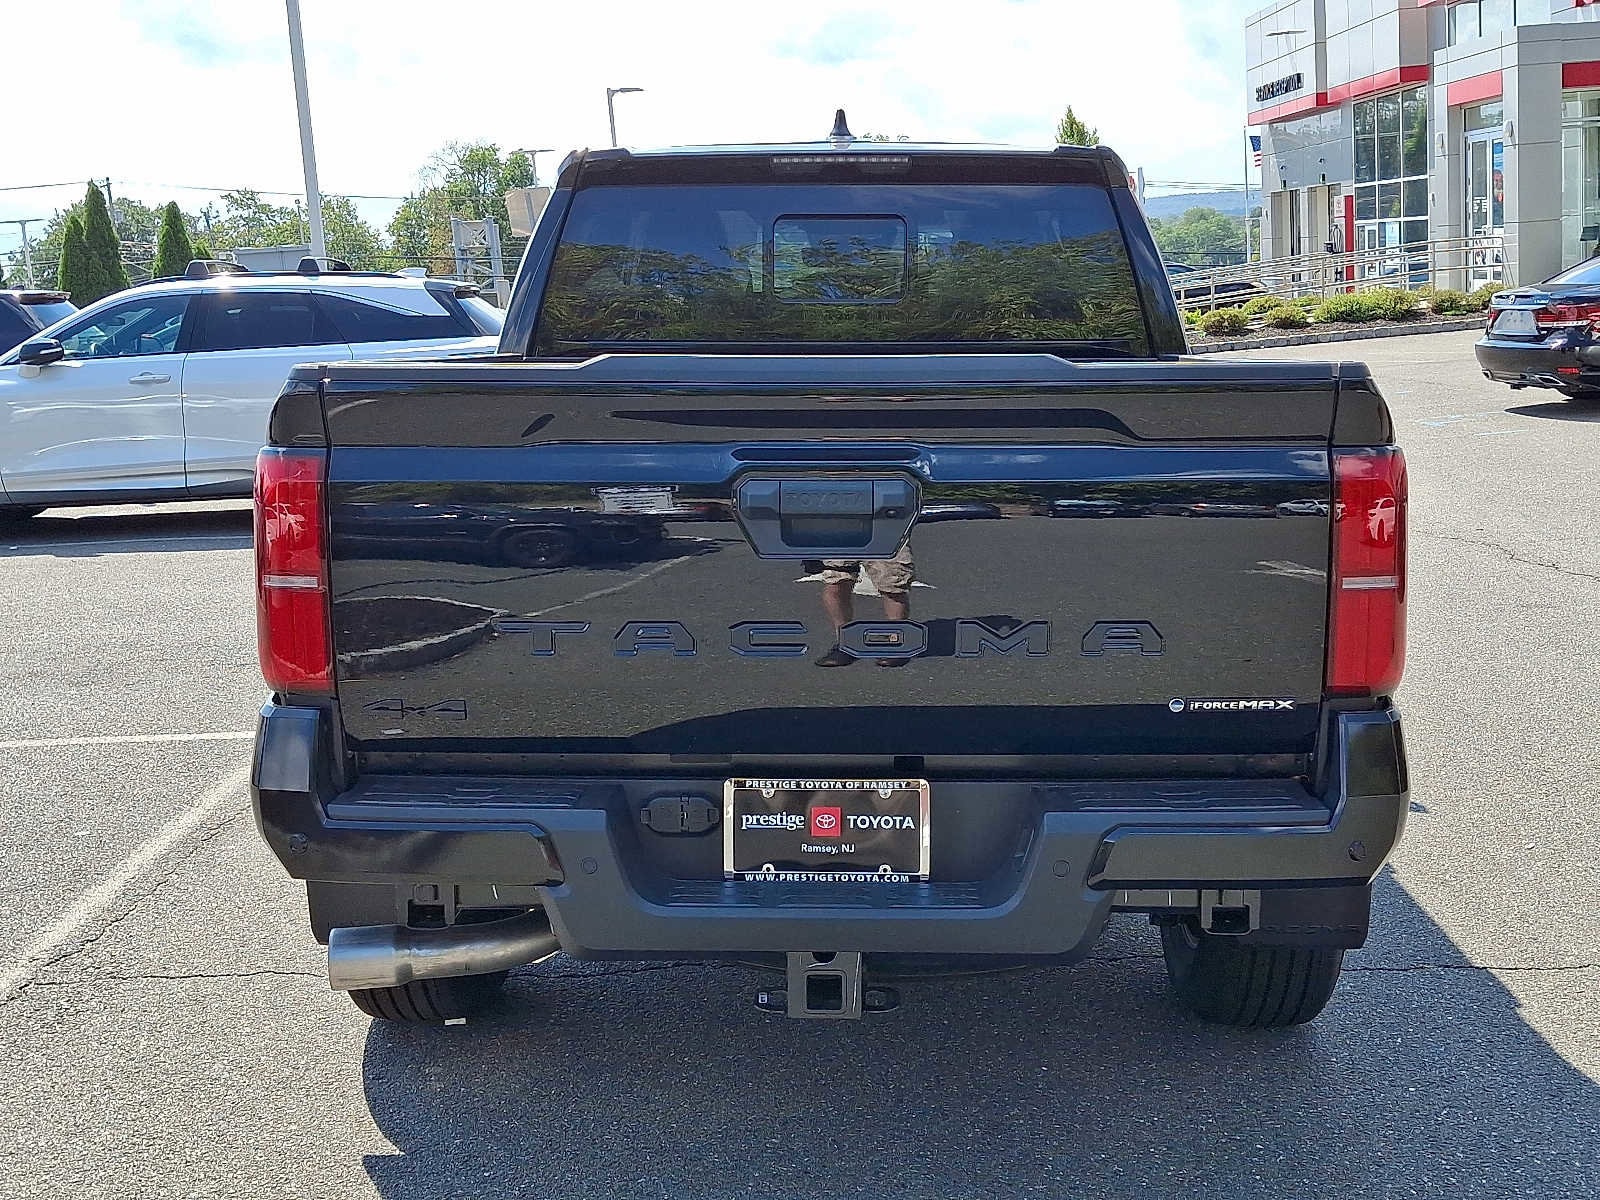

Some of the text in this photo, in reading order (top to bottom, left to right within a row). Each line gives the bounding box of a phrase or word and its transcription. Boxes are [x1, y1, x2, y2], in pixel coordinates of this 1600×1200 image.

[491, 619, 1166, 657] TACOMA
[745, 780, 907, 789] PRESTIGE TOYOTA OF RAMSEY
[741, 812, 915, 831] prestige TOYOTA
[801, 843, 855, 853] Ramsey, NJ
[744, 873, 910, 883] WWW.PRESTIGETOYOTA.COM
